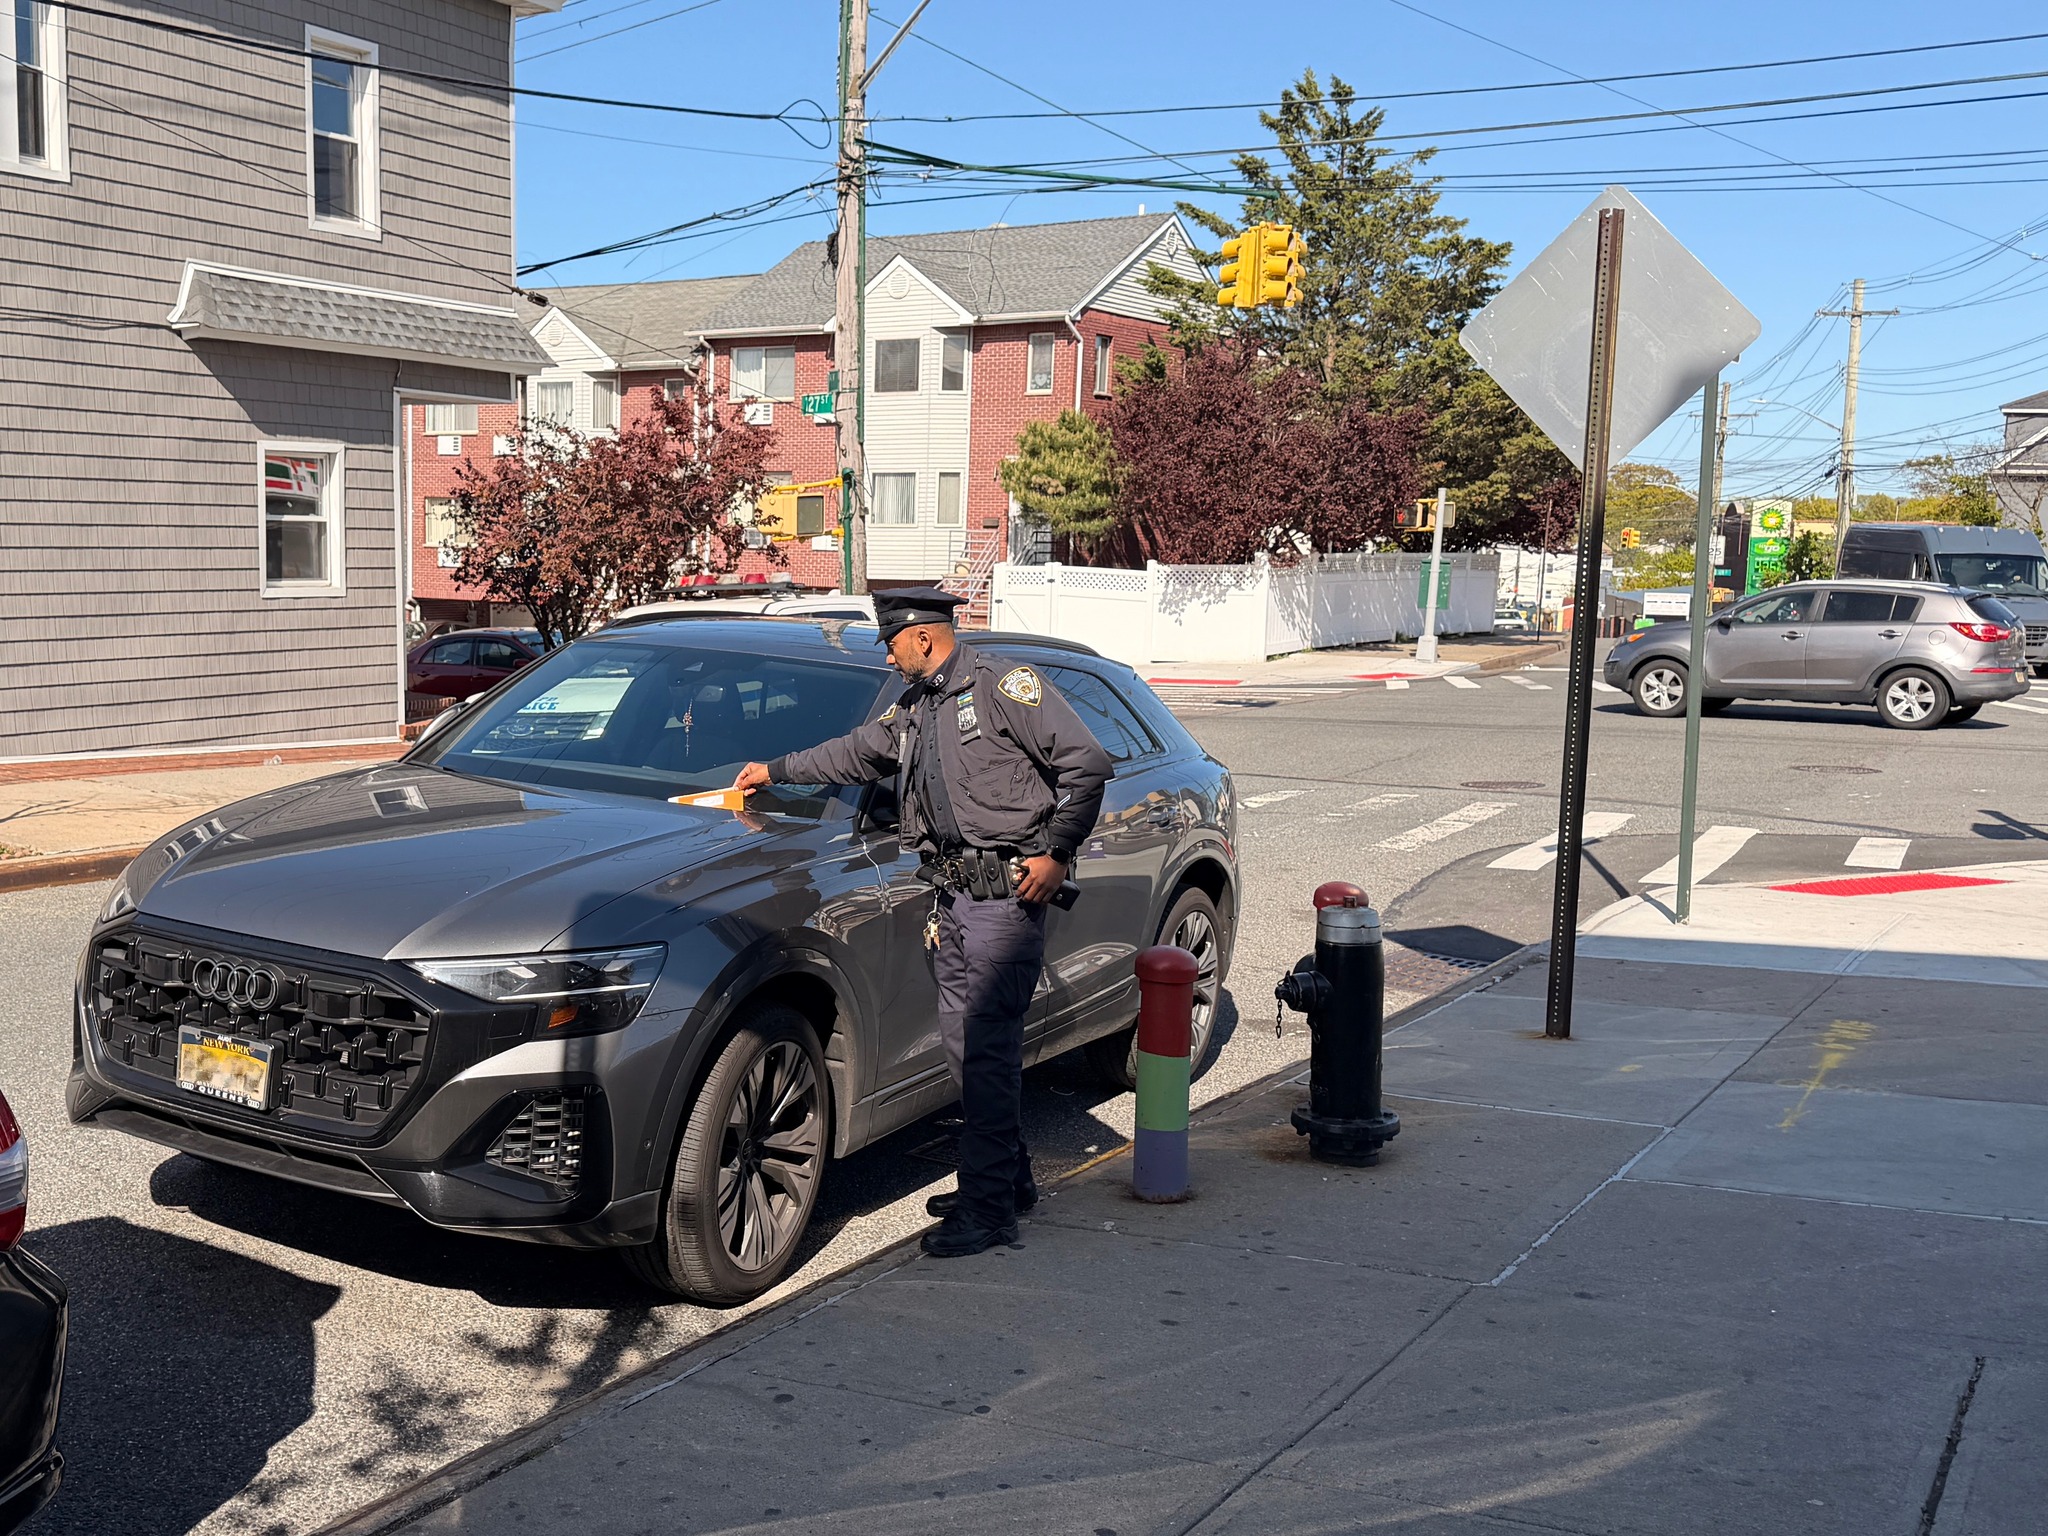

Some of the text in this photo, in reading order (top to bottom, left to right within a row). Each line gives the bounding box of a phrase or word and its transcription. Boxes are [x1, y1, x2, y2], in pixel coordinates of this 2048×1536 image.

[805, 396, 820, 413] 127
[1708, 547, 1722, 556] 25
[522, 702, 560, 711] LICE
[203, 1037, 250, 1056] NEW YORK
[198, 1085, 243, 1103] QUEENS
